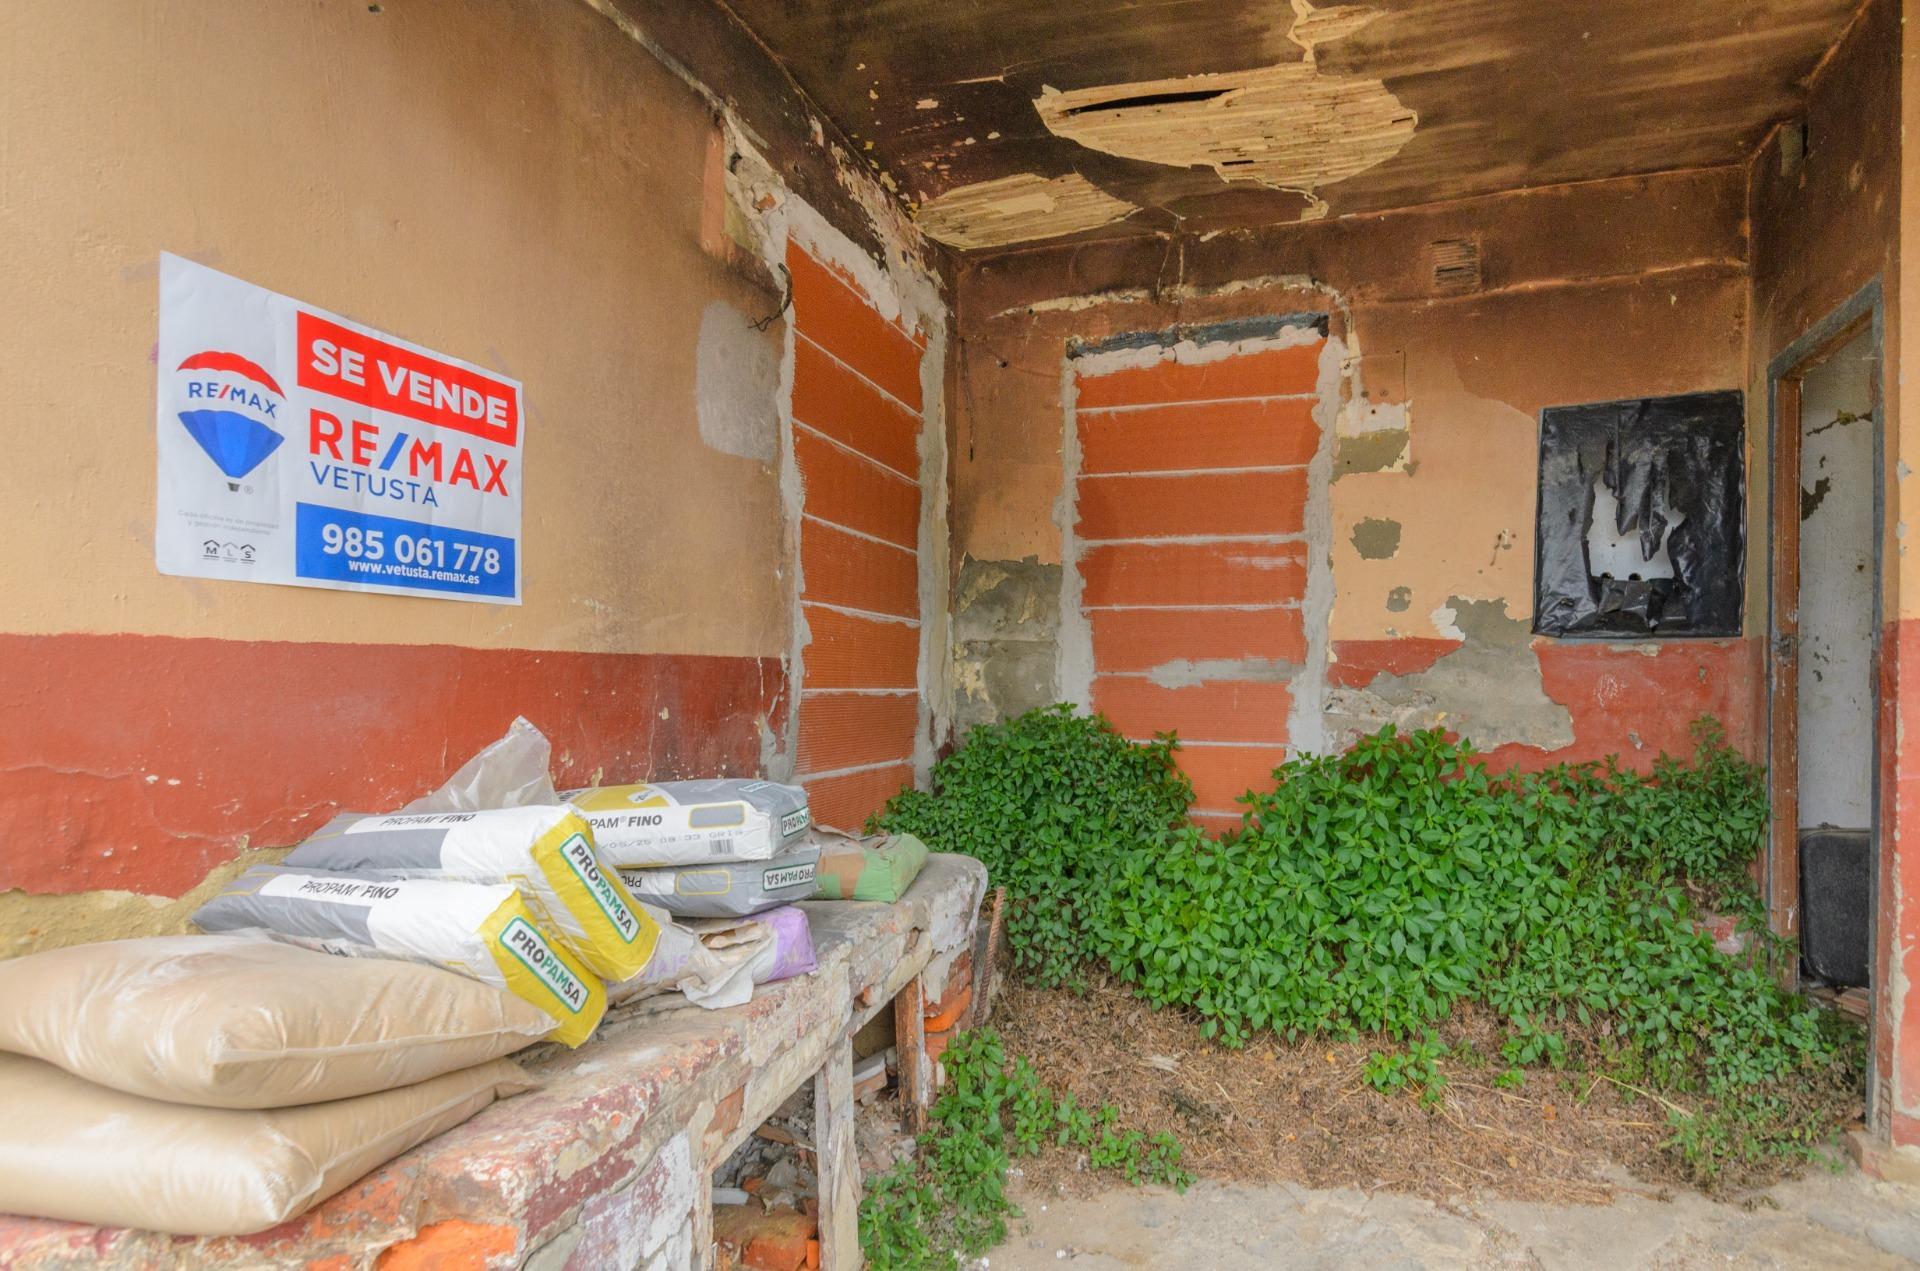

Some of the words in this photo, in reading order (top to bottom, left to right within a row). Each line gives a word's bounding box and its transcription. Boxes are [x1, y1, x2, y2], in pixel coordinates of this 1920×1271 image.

[188, 381, 278, 419] RE/MAX
[311, 338, 365, 387] SE
[376, 359, 508, 429] VENDE
[309, 407, 509, 498] RE/MAX
[310, 461, 439, 508] VETUSTA
[321, 523, 385, 560] 985
[394, 534, 446, 569] 061
[453, 546, 501, 575] 778
[348, 560, 480, 586] www.vetusta.remax.es
[439, 813, 477, 823] FINO
[628, 814, 663, 828] FINO
[299, 879, 358, 897] PROPAM
[361, 884, 399, 900] FINO
[571, 844, 632, 934] PROPAMSA
[767, 866, 815, 887] PROPAMSA
[511, 929, 580, 1006] PROPAMSA
